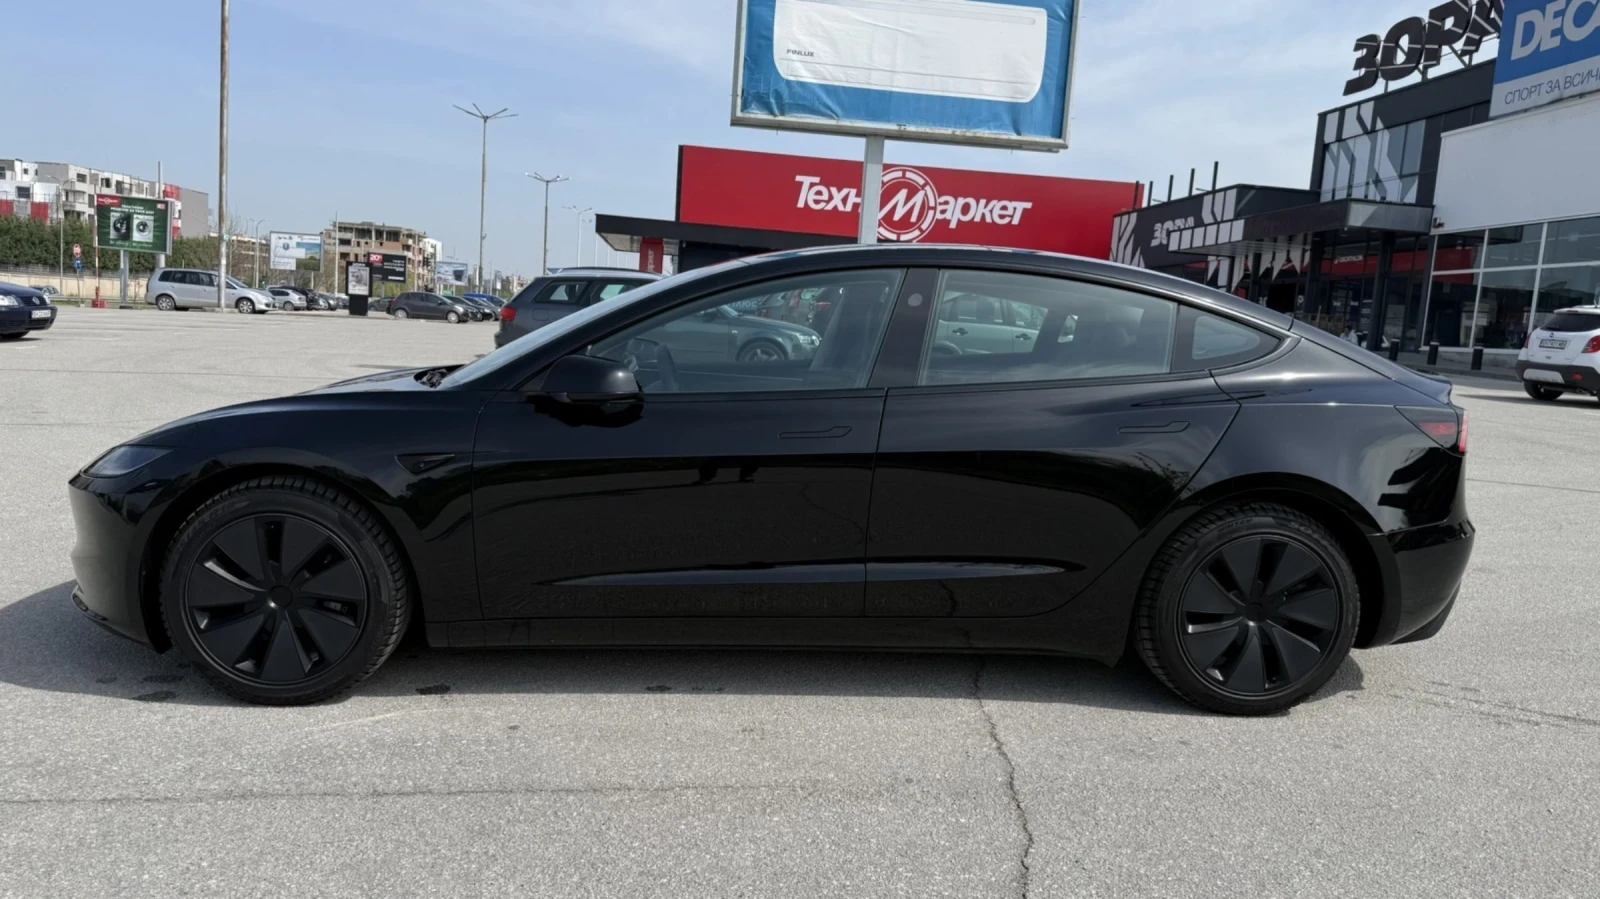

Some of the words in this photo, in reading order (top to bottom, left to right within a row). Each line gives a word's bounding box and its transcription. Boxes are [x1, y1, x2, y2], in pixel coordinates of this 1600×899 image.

[786, 48, 815, 57] FINLUX
[1504, 82, 1544, 105] СПОРТ
[1545, 78, 1561, 95] ЗА
[1563, 67, 1600, 90] ВСИЧ
